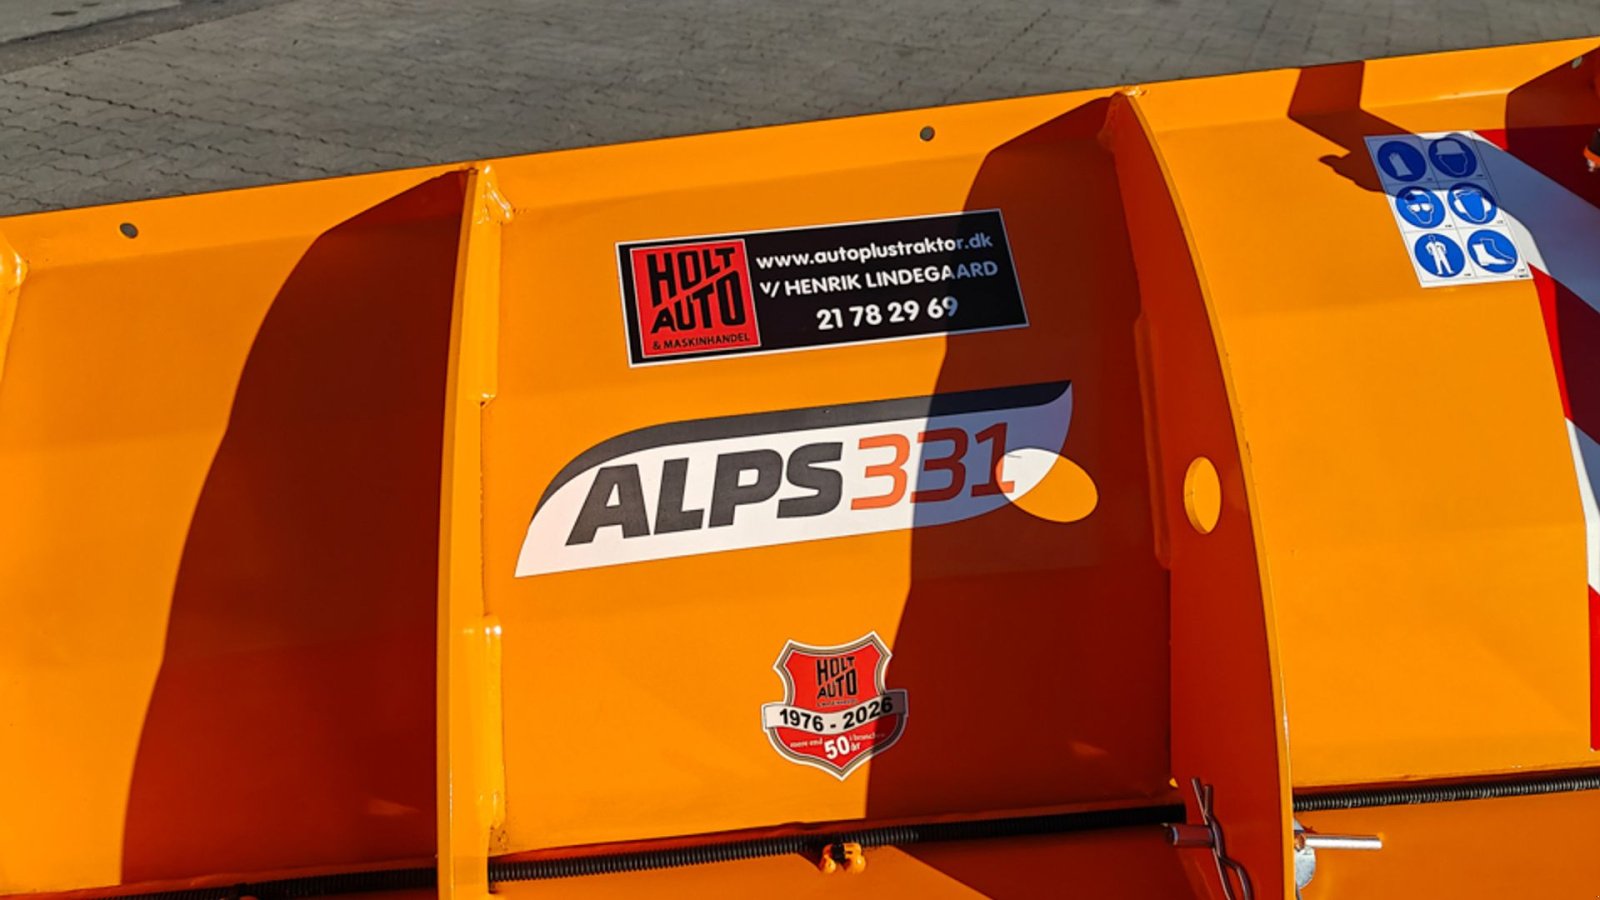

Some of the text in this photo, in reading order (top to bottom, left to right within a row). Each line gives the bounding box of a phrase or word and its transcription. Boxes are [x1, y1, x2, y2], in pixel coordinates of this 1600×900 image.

[756, 233, 992, 270] www.autoplustraktor.dk
[646, 247, 735, 308] HOLT
[785, 274, 861, 298] HENRIK
[866, 260, 998, 288] LINDEGAARD
[651, 273, 745, 334] AUTO
[816, 296, 958, 331] 21 78 29 69
[652, 333, 750, 350] & MASKINHANDEL
[816, 656, 855, 685] HOLT
[817, 669, 857, 699] AUTO
[780, 708, 824, 732] 1976
[843, 697, 893, 729] 2026
[824, 735, 850, 760] 50
